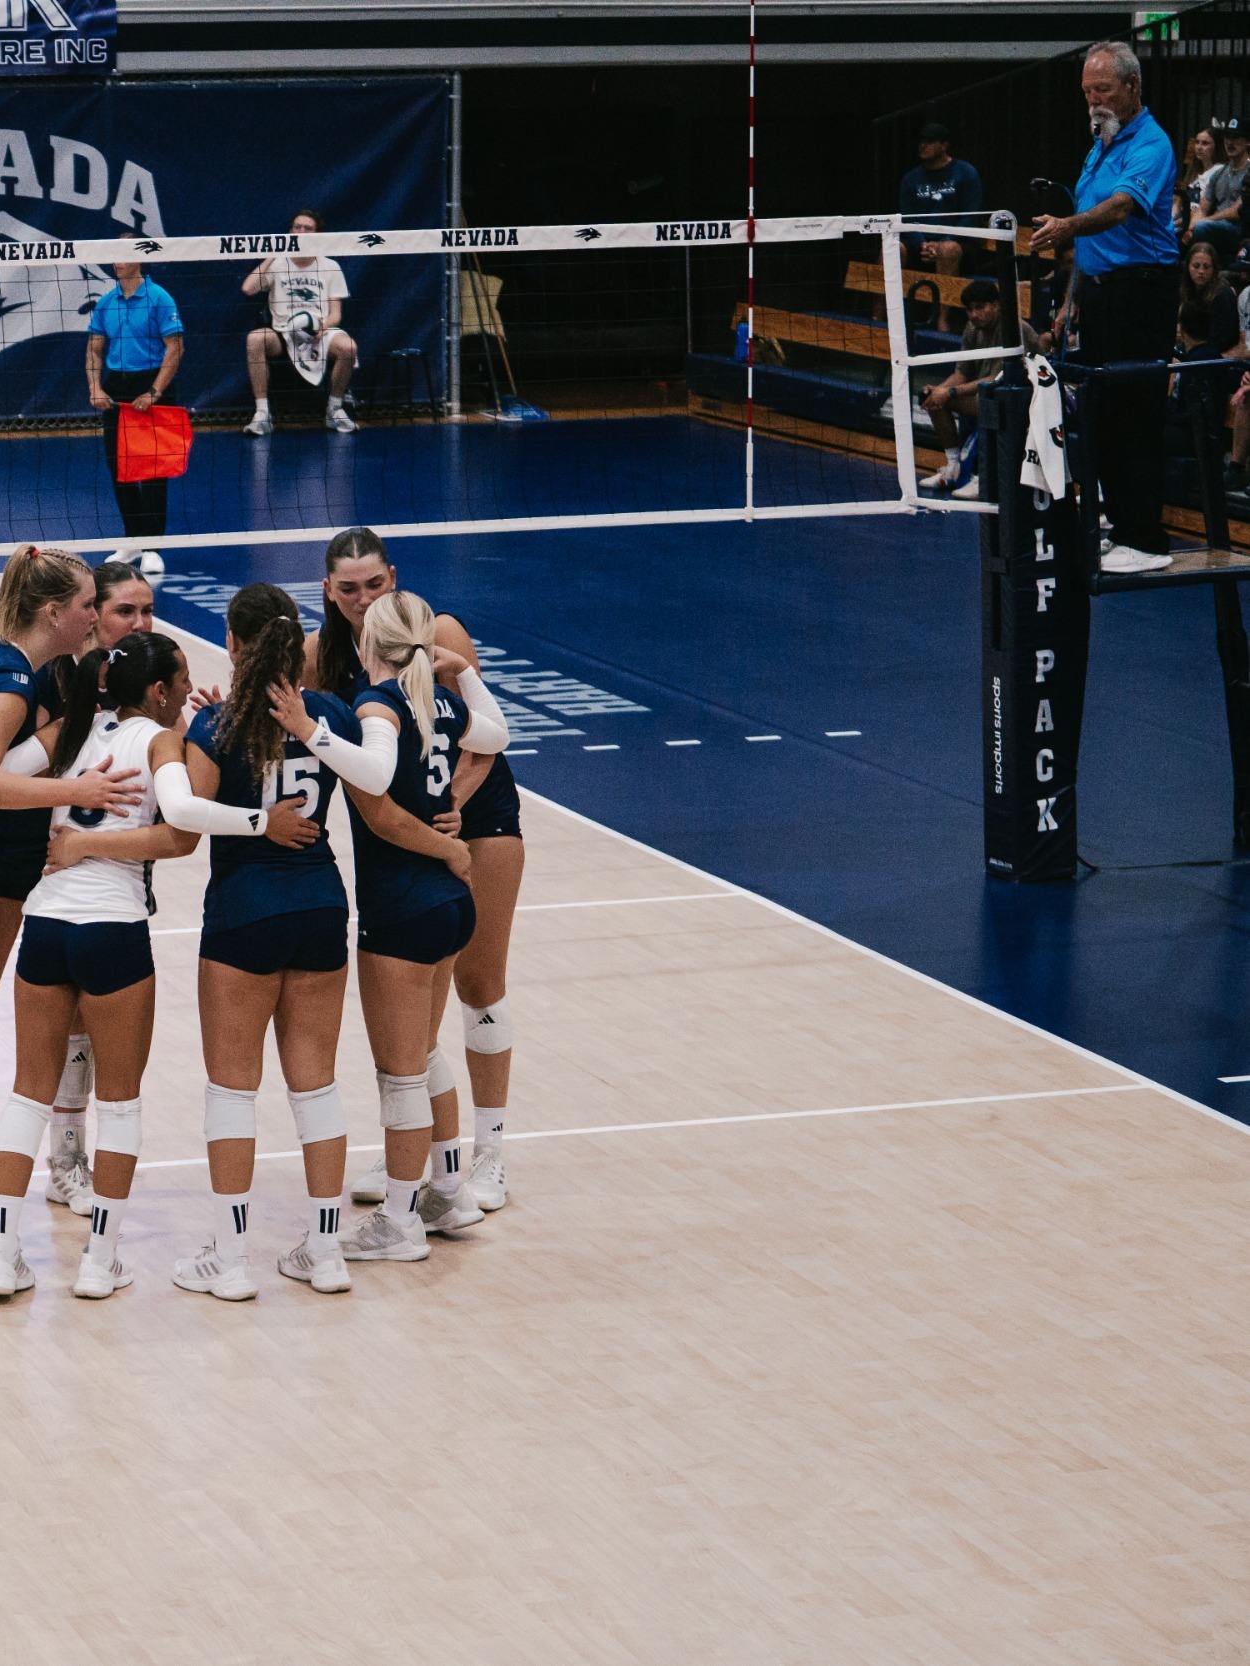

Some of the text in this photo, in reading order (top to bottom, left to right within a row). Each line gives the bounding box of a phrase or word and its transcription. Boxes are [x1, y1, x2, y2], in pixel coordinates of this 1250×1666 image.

[54, 38, 108, 64] INC
[441, 229, 518, 247] NEVADA
[656, 223, 731, 241] NEVADA
[220, 236, 299, 253] NEVADA
[992, 676, 1004, 794] sports imports
[1034, 649, 1059, 832] PACK
